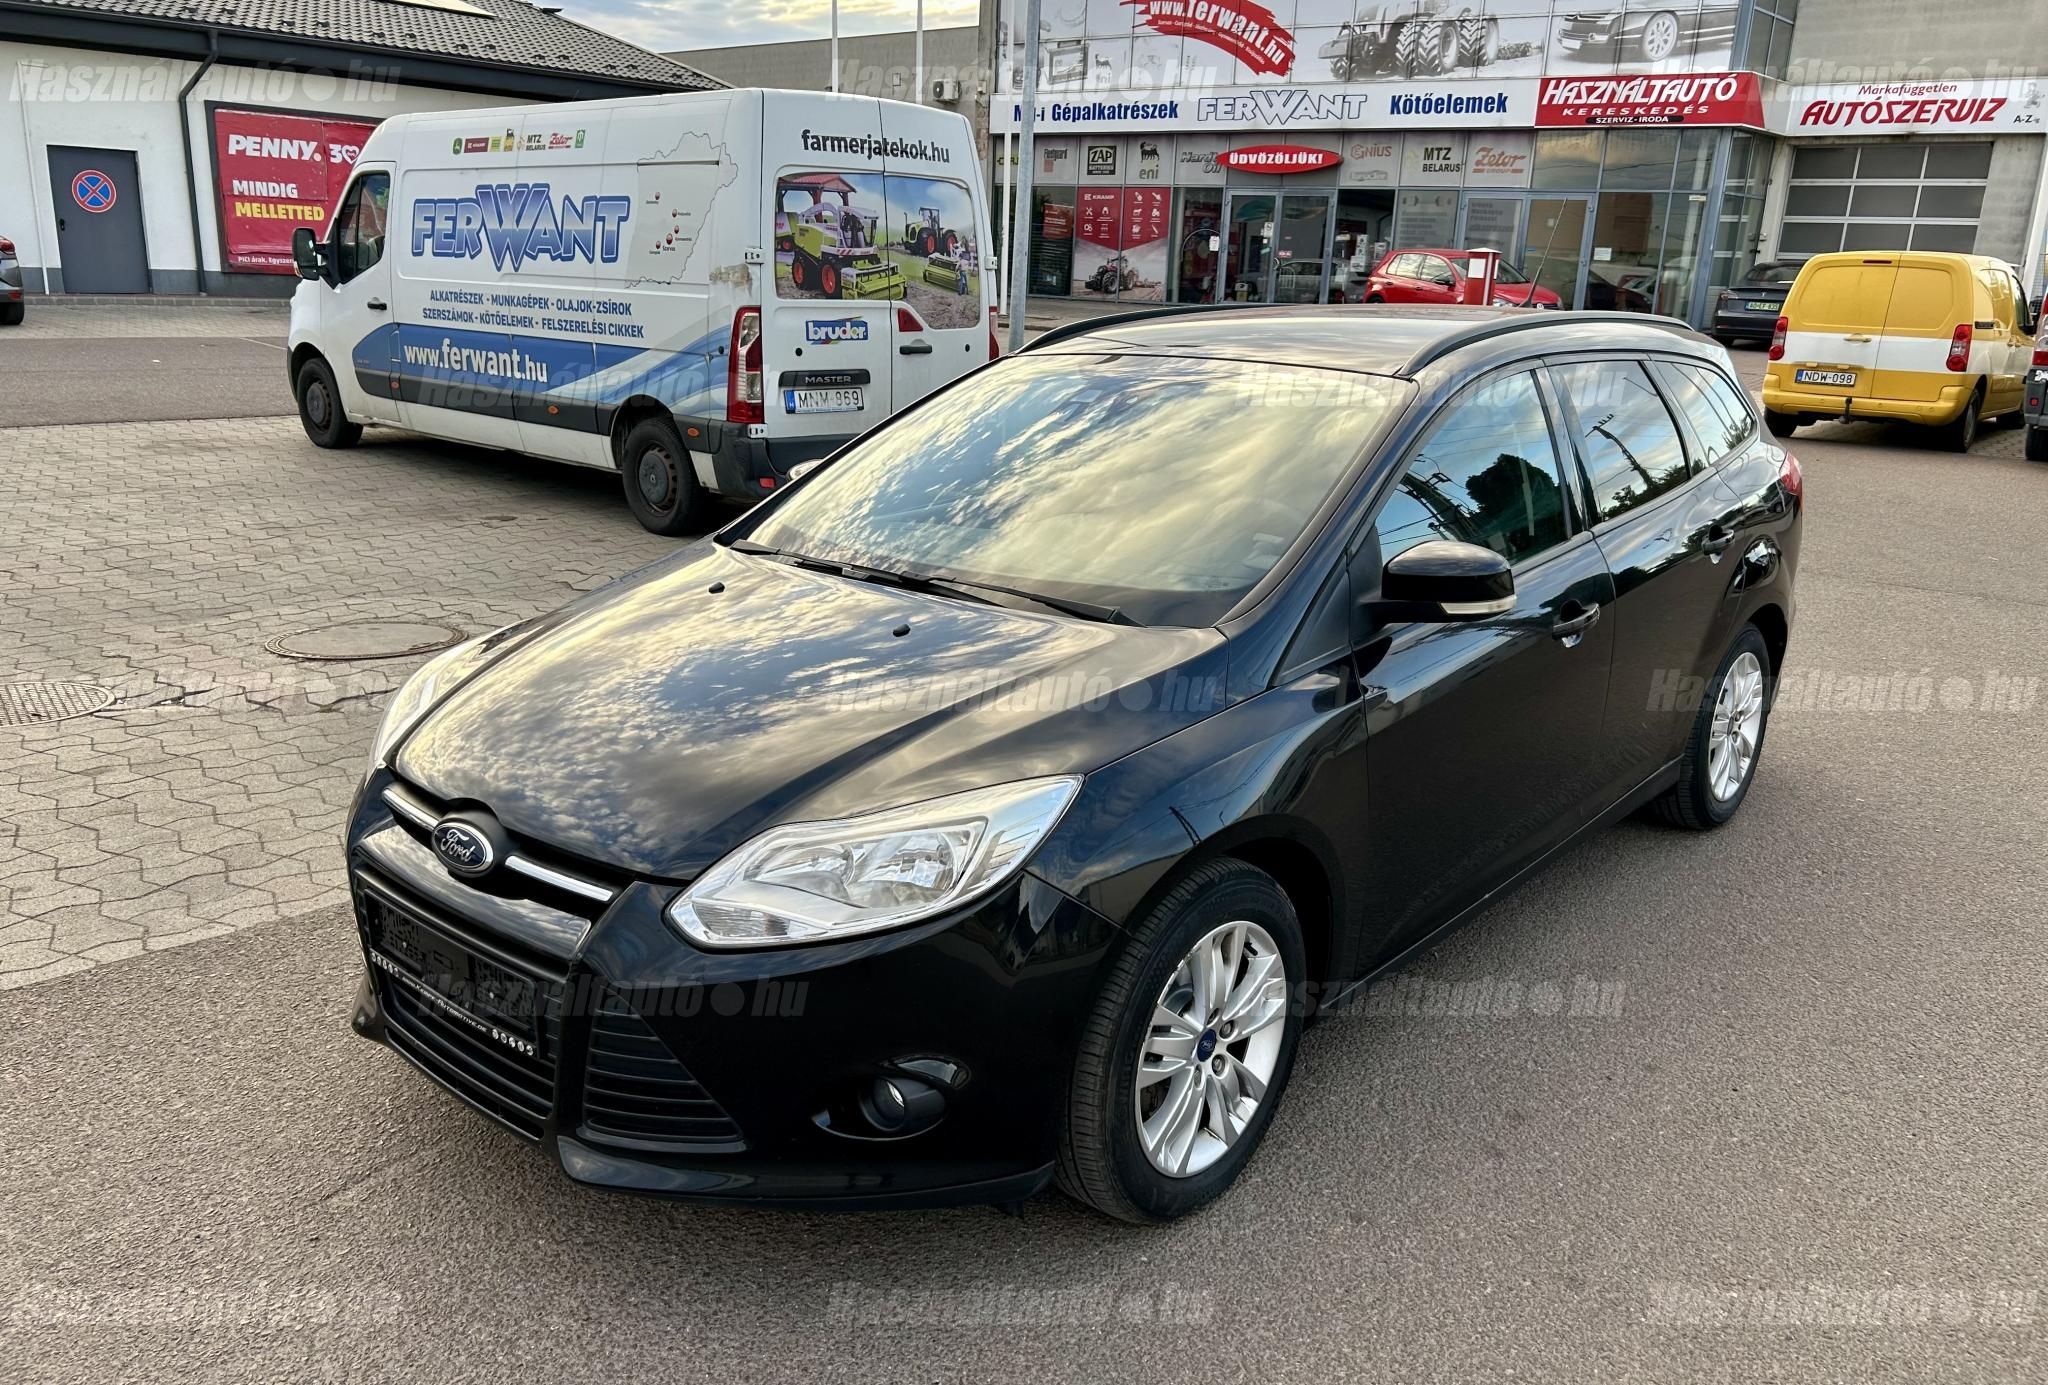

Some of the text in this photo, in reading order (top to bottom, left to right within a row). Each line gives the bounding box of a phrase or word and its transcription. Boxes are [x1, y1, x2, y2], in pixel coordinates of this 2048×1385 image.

[1542, 74, 1738, 105] HASZNÁLTAUTÓ
[1858, 82, 1958, 96] Márkafüggetlen
[1052, 101, 1178, 122] Gépalkatrészek
[1198, 90, 1367, 124] FERWANT
[1390, 93, 1508, 115] Kötőelemek
[1562, 105, 1710, 116] KERESKEDÉS
[1800, 97, 2007, 126] AUTÓSZERVIZ
[802, 130, 950, 163] farmerjatekok.hu
[1090, 150, 1112, 162] ZAP
[1424, 147, 1452, 161] MTZ
[1476, 146, 1527, 168] Zetor
[1229, 152, 1324, 164] ÜDVÖZÖLJÜK!
[1422, 164, 1460, 172] BELARUS
[1139, 166, 1159, 180] eni
[232, 180, 298, 198] MINDIG
[236, 202, 324, 221] MELLETTED
[412, 183, 630, 272] FERWANT
[430, 288, 484, 305] ALKATRÉSZEK
[491, 294, 549, 310] MUNKAGÉPEK
[422, 308, 644, 338] SZERSZÁMOK KÖTŐELEMEK FELSZERELÉSI CIKKEK
[404, 338, 548, 383] www.ferwant.hu
[805, 376, 852, 384] MASTER
[1804, 373, 1853, 384] NDW-098
[440, 829, 476, 862] Ford
